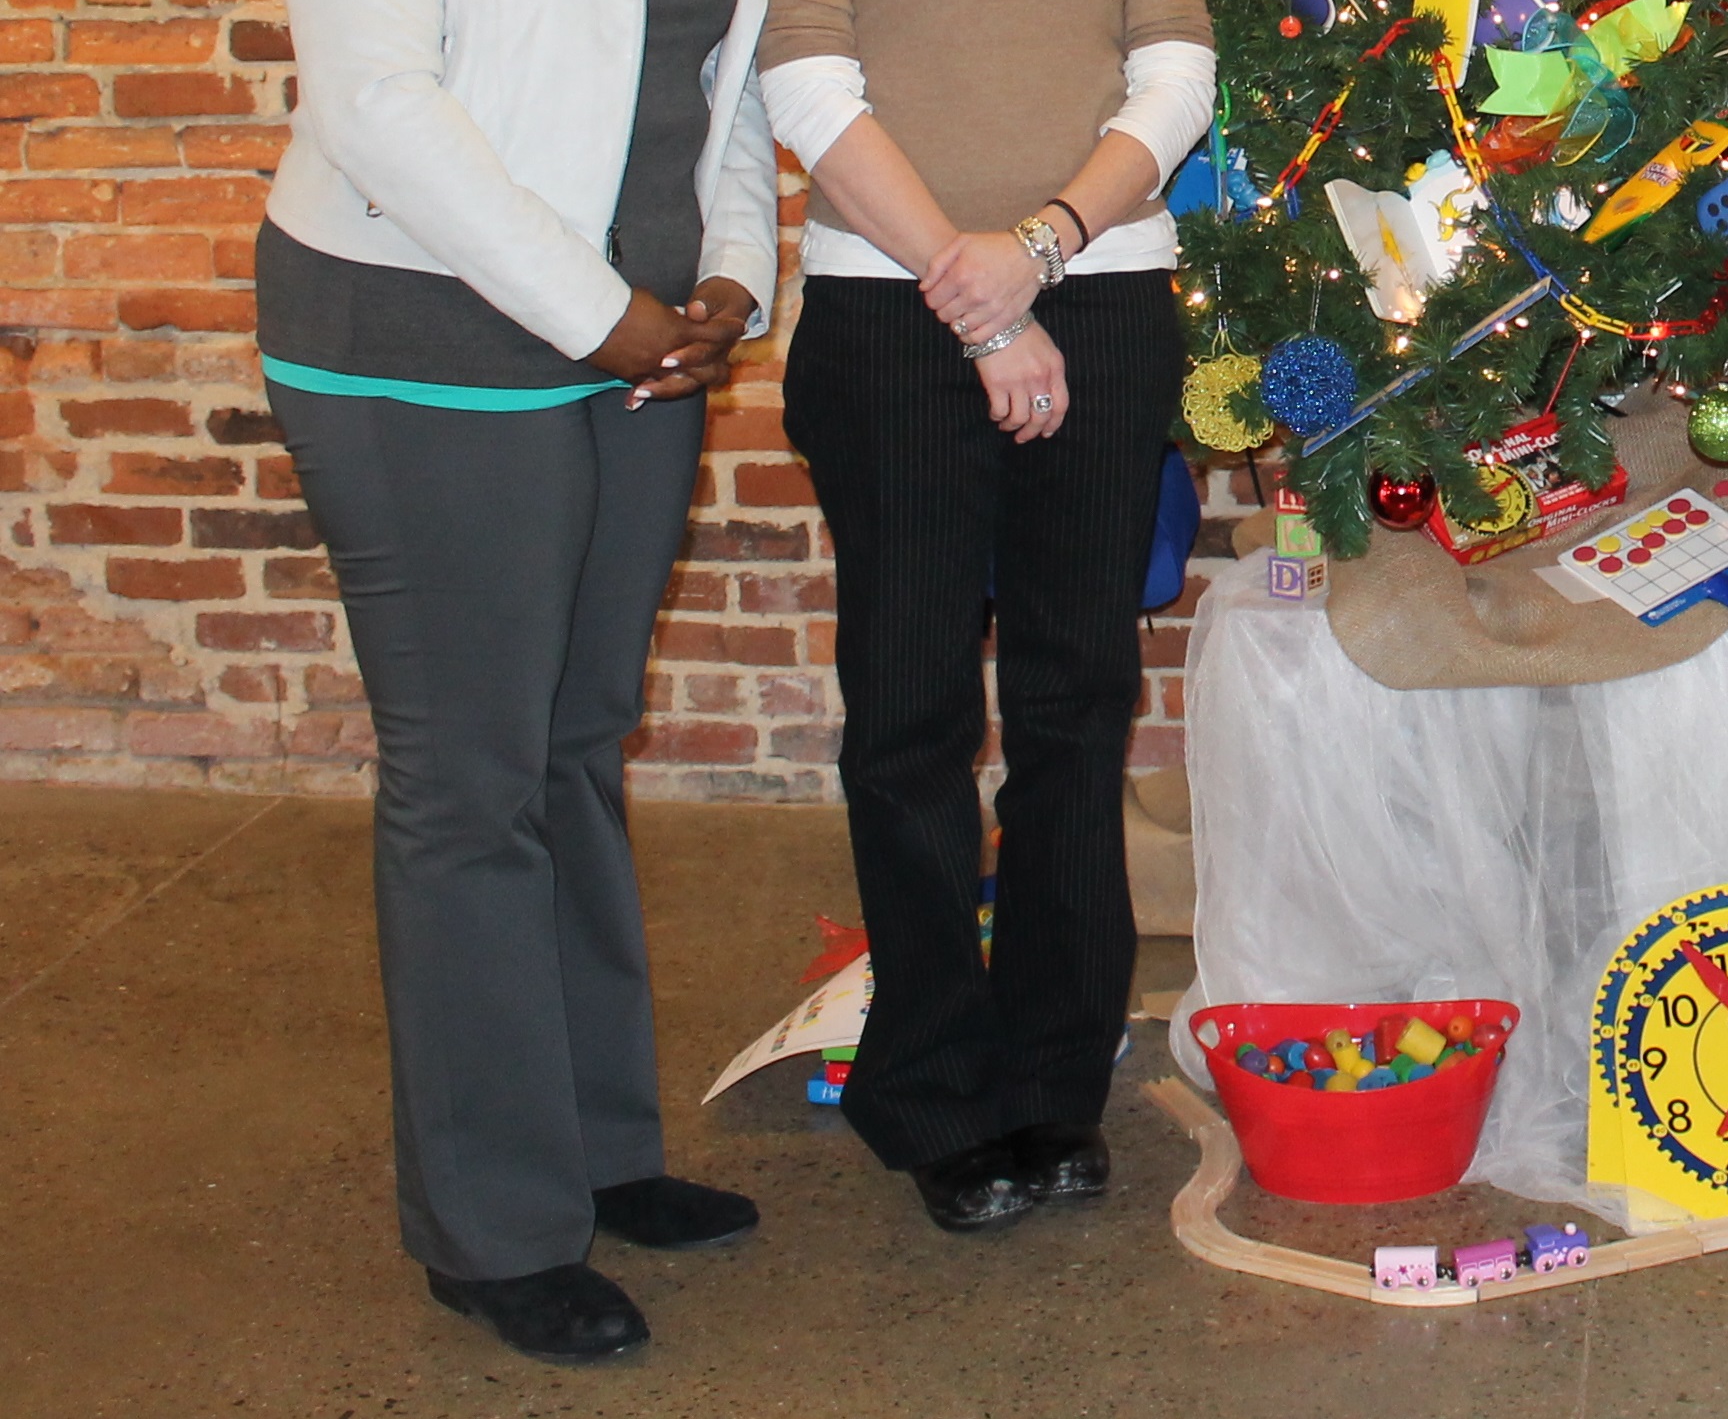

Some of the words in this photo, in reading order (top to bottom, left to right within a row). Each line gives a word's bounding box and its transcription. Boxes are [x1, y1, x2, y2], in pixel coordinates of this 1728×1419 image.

[1466, 432, 1532, 462] OINAL
[1499, 433, 1561, 463] MINI-CLO
[1527, 504, 1578, 529] ORIGINAL
[1545, 495, 1618, 530] MINI-CLOCKS
[1274, 563, 1299, 591] D
[1657, 994, 1699, 1029] 10
[1642, 1046, 1668, 1081] 9
[1666, 1098, 1693, 1134] 8
